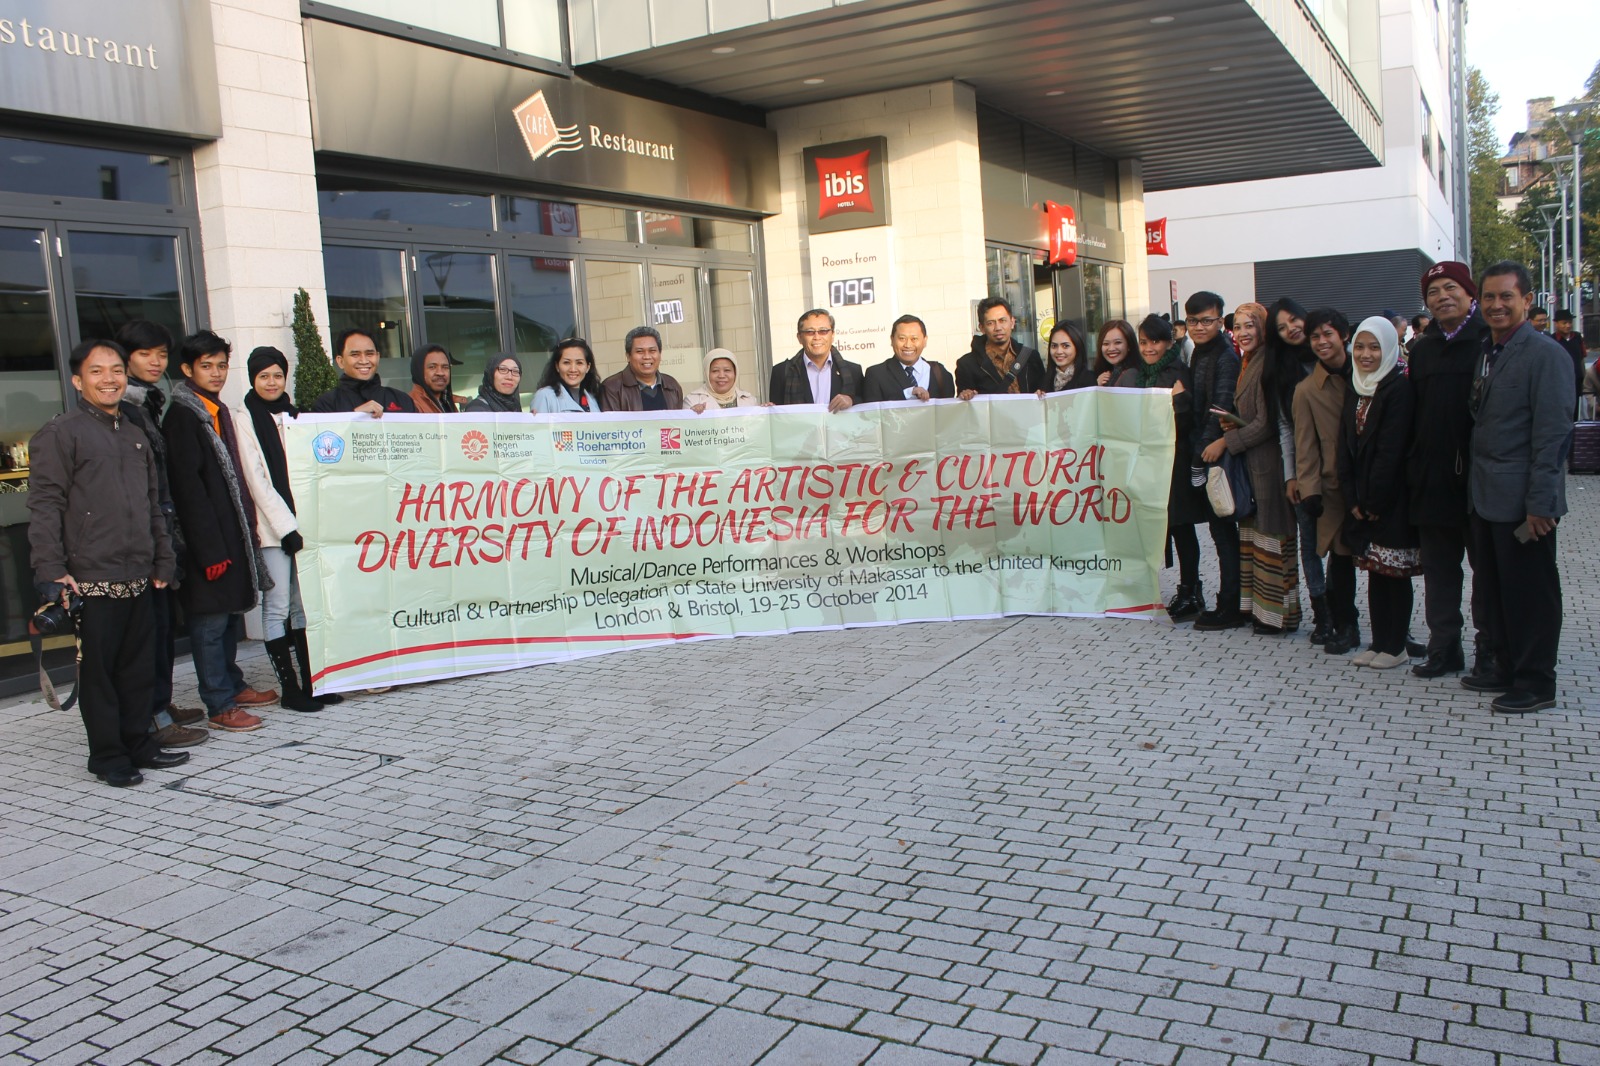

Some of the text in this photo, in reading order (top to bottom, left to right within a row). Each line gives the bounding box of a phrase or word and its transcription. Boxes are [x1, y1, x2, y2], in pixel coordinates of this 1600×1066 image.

[0, 17, 159, 70] staurant
[525, 113, 549, 136] CAFÉ
[589, 124, 675, 161] Restaurant
[825, 170, 865, 198] ibis
[822, 252, 877, 268] Rooms from
[830, 278, 874, 307] 095
[835, 340, 876, 352] ibis.com
[352, 432, 378, 441] Ministry
[386, 432, 418, 440] Education
[425, 432, 448, 440] Culture
[493, 432, 535, 441] Universitas
[576, 428, 643, 442] University of
[660, 429, 669, 449] UWE
[684, 428, 719, 437] University
[720, 426, 729, 434] of
[352, 440, 382, 448] Republic
[576, 441, 646, 452] Roehampton
[684, 438, 703, 447] West
[714, 435, 746, 446] England
[352, 446, 389, 454] Directorate
[391, 446, 415, 454] General
[353, 453, 409, 462] Higher Education
[493, 450, 533, 459] Makassar
[395, 475, 590, 523] HARMONY
[598, 473, 646, 513] OF
[654, 469, 724, 509] THE
[727, 461, 894, 504] ARTISTIC
[899, 459, 927, 494] &
[354, 484, 1132, 573] DIVERSITY OF INDONESIA FOR THE WORD
[571, 542, 946, 587] Musical/Dance Performances & Workshops
[392, 554, 1122, 629] Cultural & Partnership Delegation of State University of Makassar to the United Kingdom
[595, 583, 929, 631] London & Bristol, 19-25 October 2014
